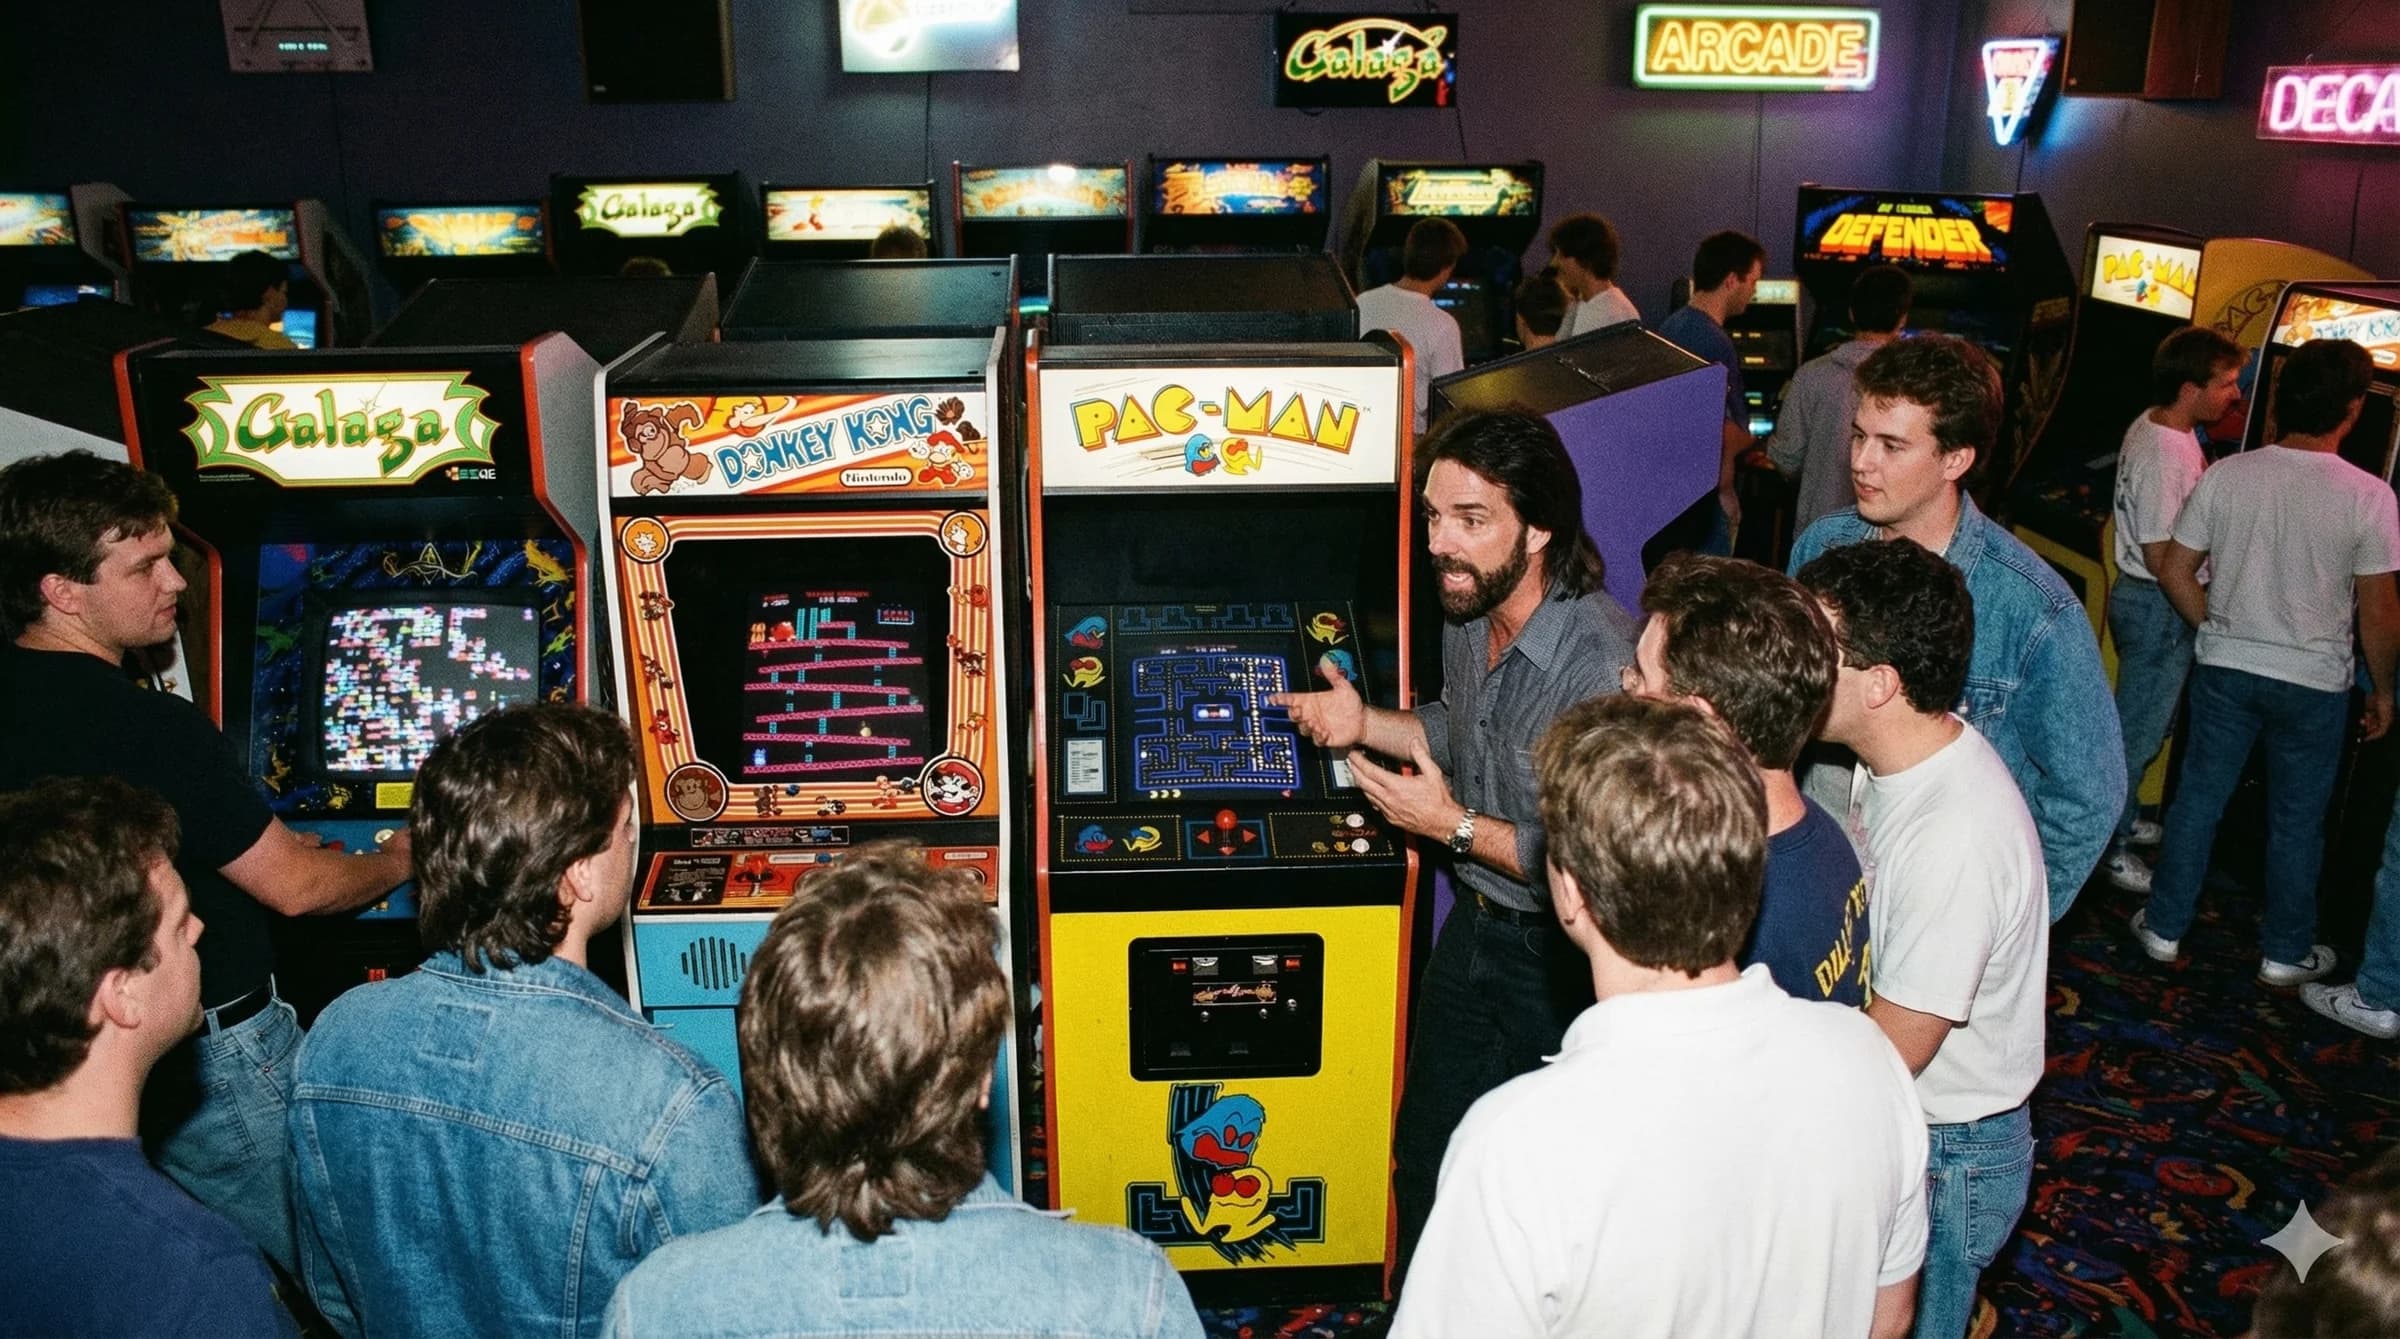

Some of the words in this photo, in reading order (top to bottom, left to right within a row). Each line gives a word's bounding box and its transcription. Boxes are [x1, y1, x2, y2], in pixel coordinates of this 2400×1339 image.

[1285, 18, 1447, 104] Galaga
[1651, 20, 1867, 75] ARCADE
[601, 192, 697, 232] Galaga
[1819, 213, 1993, 262] DEFENDER
[235, 388, 450, 479] Galaga
[714, 418, 838, 487] DONKEY
[843, 395, 938, 454] KONG
[1070, 384, 1360, 454] PAC-MAN
